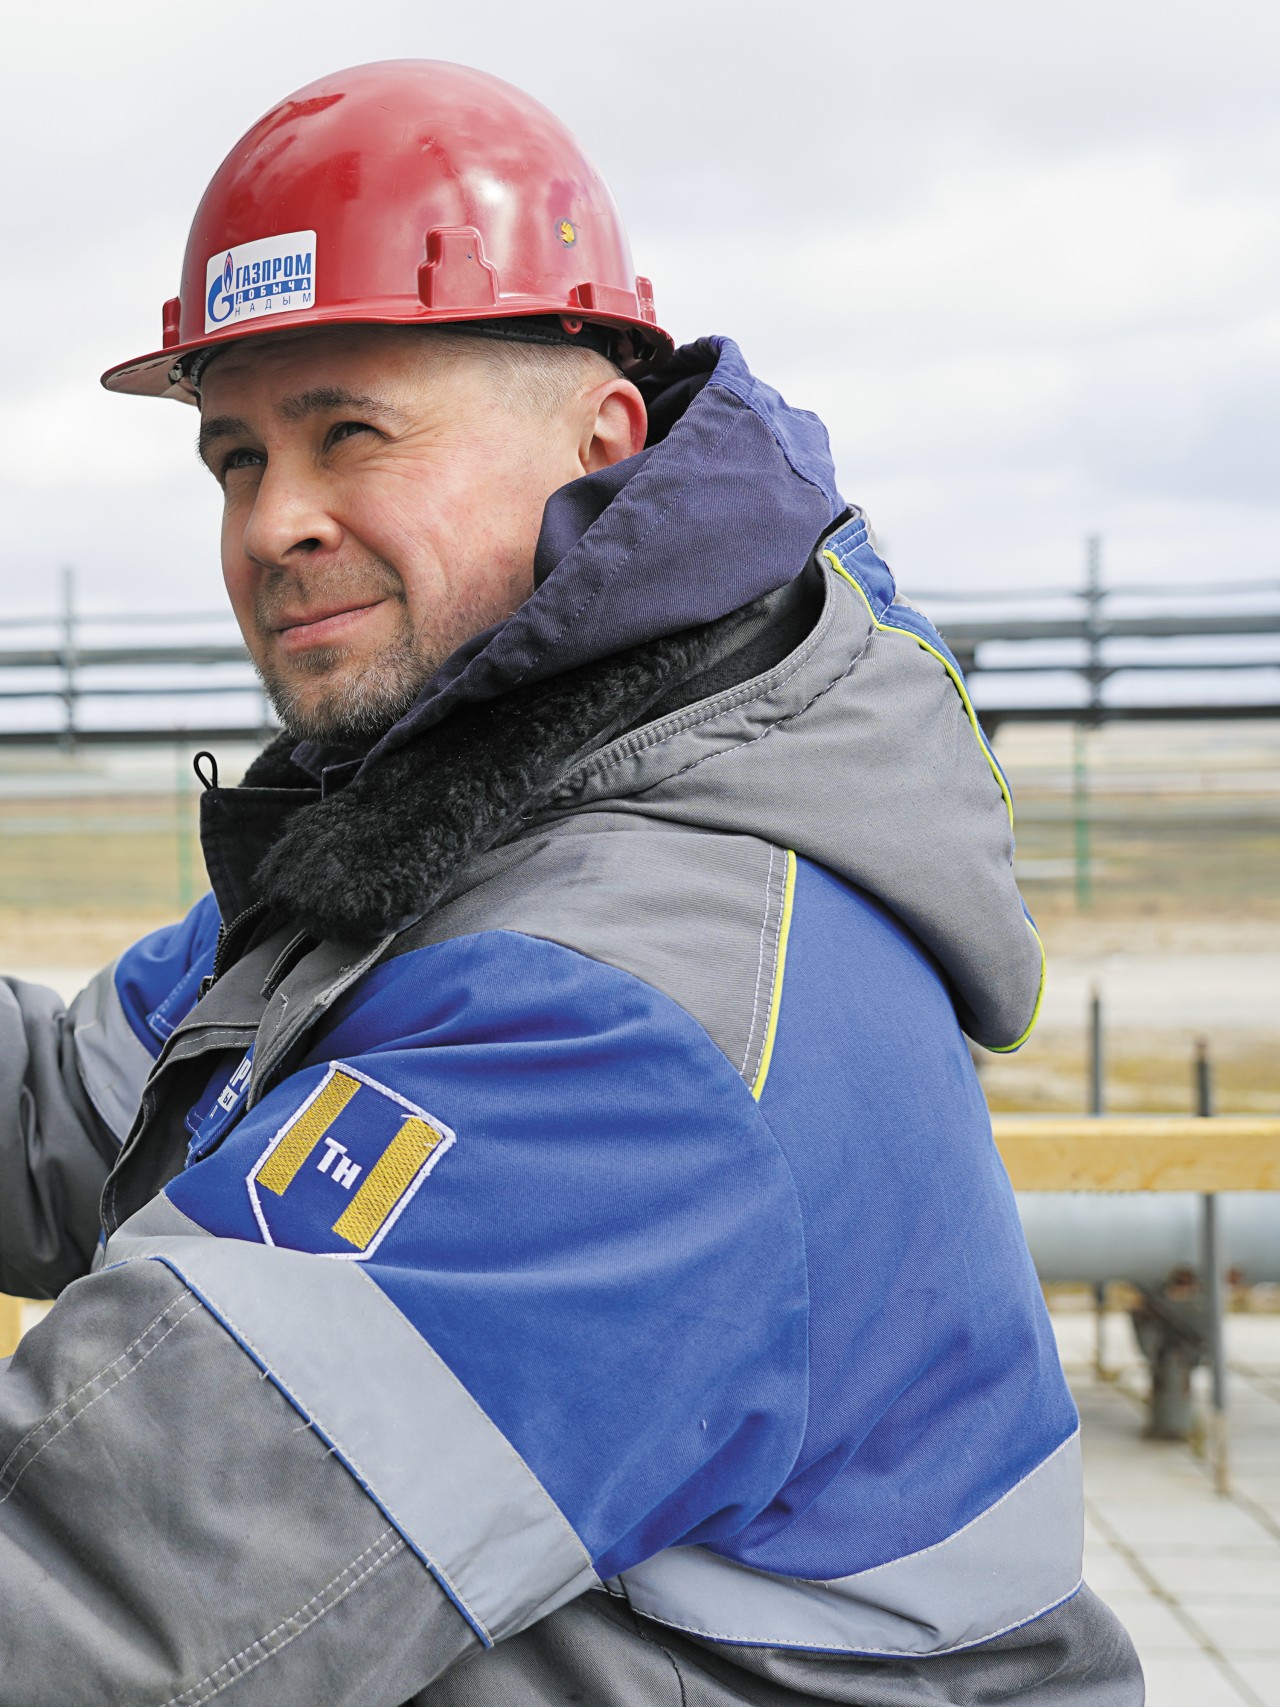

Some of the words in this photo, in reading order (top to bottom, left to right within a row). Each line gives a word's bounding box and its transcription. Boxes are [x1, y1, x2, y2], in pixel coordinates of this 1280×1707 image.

[236, 253, 311, 289] ГАЗПРОМ
[236, 279, 309, 304] ДОБЫЧА
[235, 293, 311, 316] НАДЫМ
